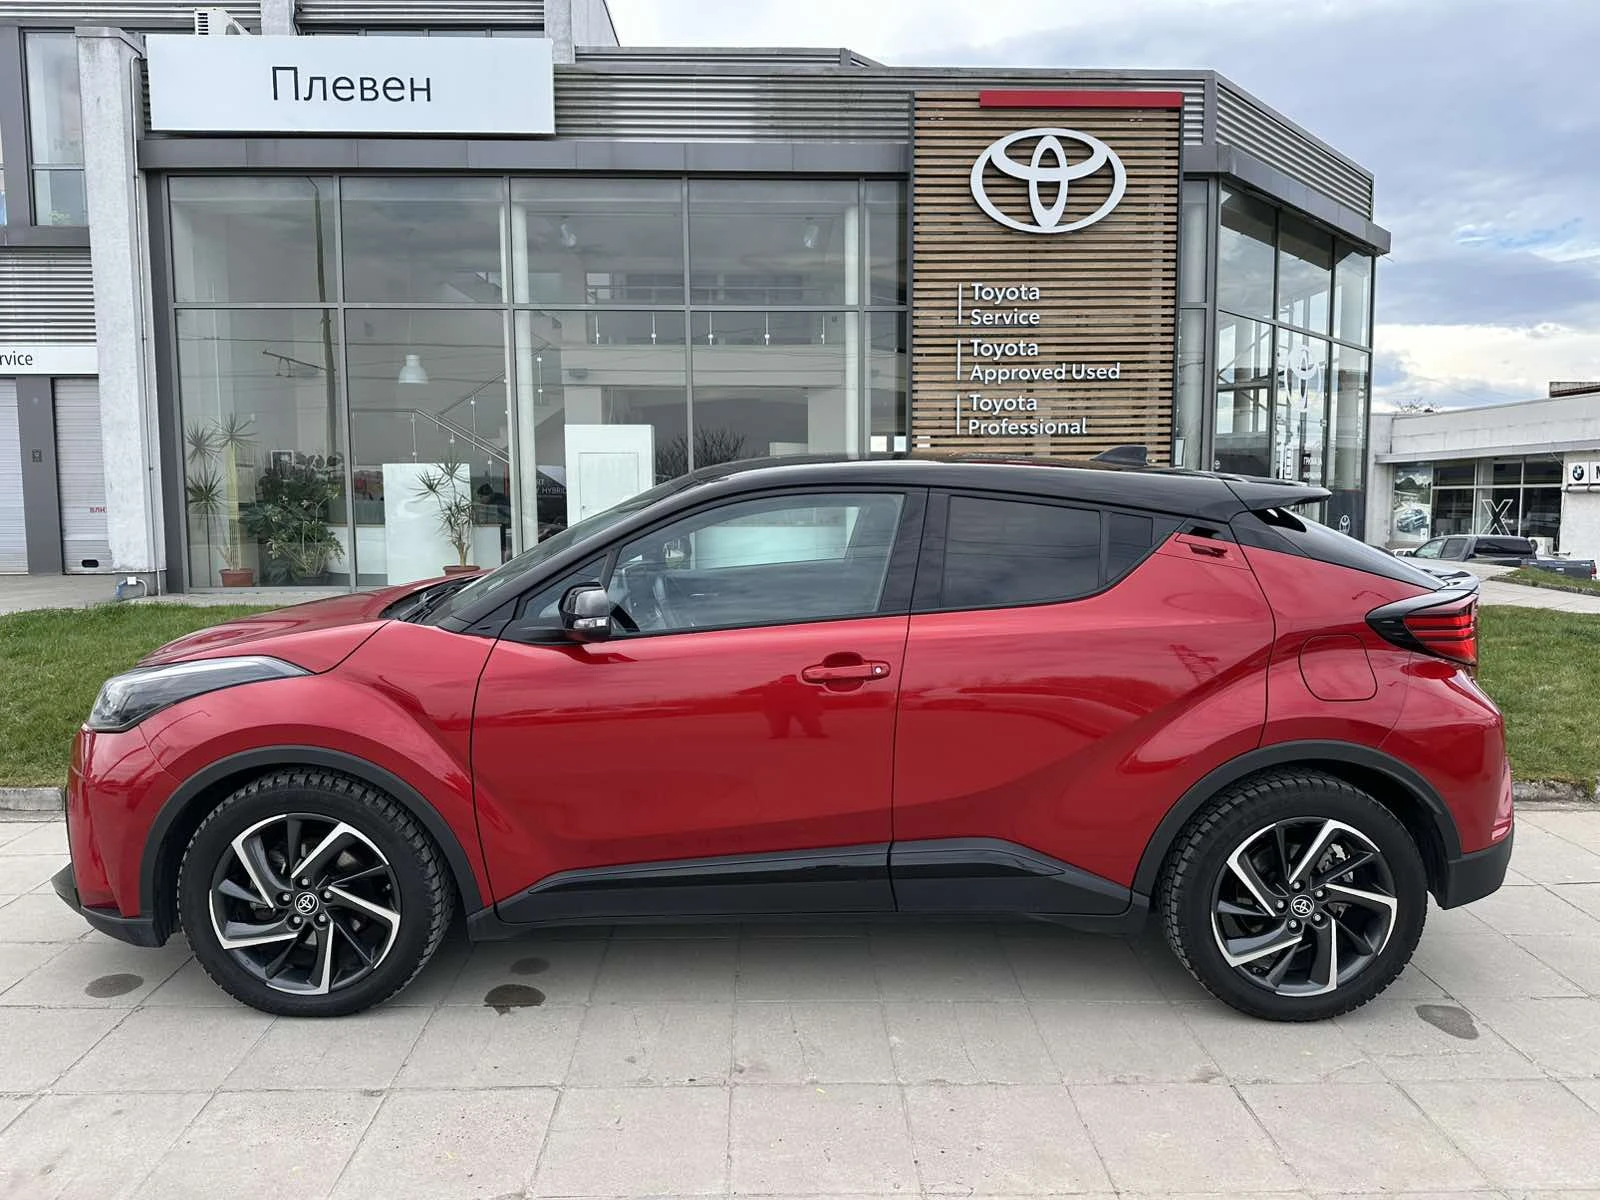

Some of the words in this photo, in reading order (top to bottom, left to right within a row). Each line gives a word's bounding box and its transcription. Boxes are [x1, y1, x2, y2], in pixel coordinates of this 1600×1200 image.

[271, 66, 432, 102] Плевен
[971, 283, 1040, 305] Toyota
[970, 308, 1040, 325] Service
[969, 339, 1039, 361] Toyota
[969, 363, 1066, 385] Approved
[1071, 362, 1121, 380] Used
[969, 394, 1038, 415] Toyota
[968, 417, 1088, 435] Professional
